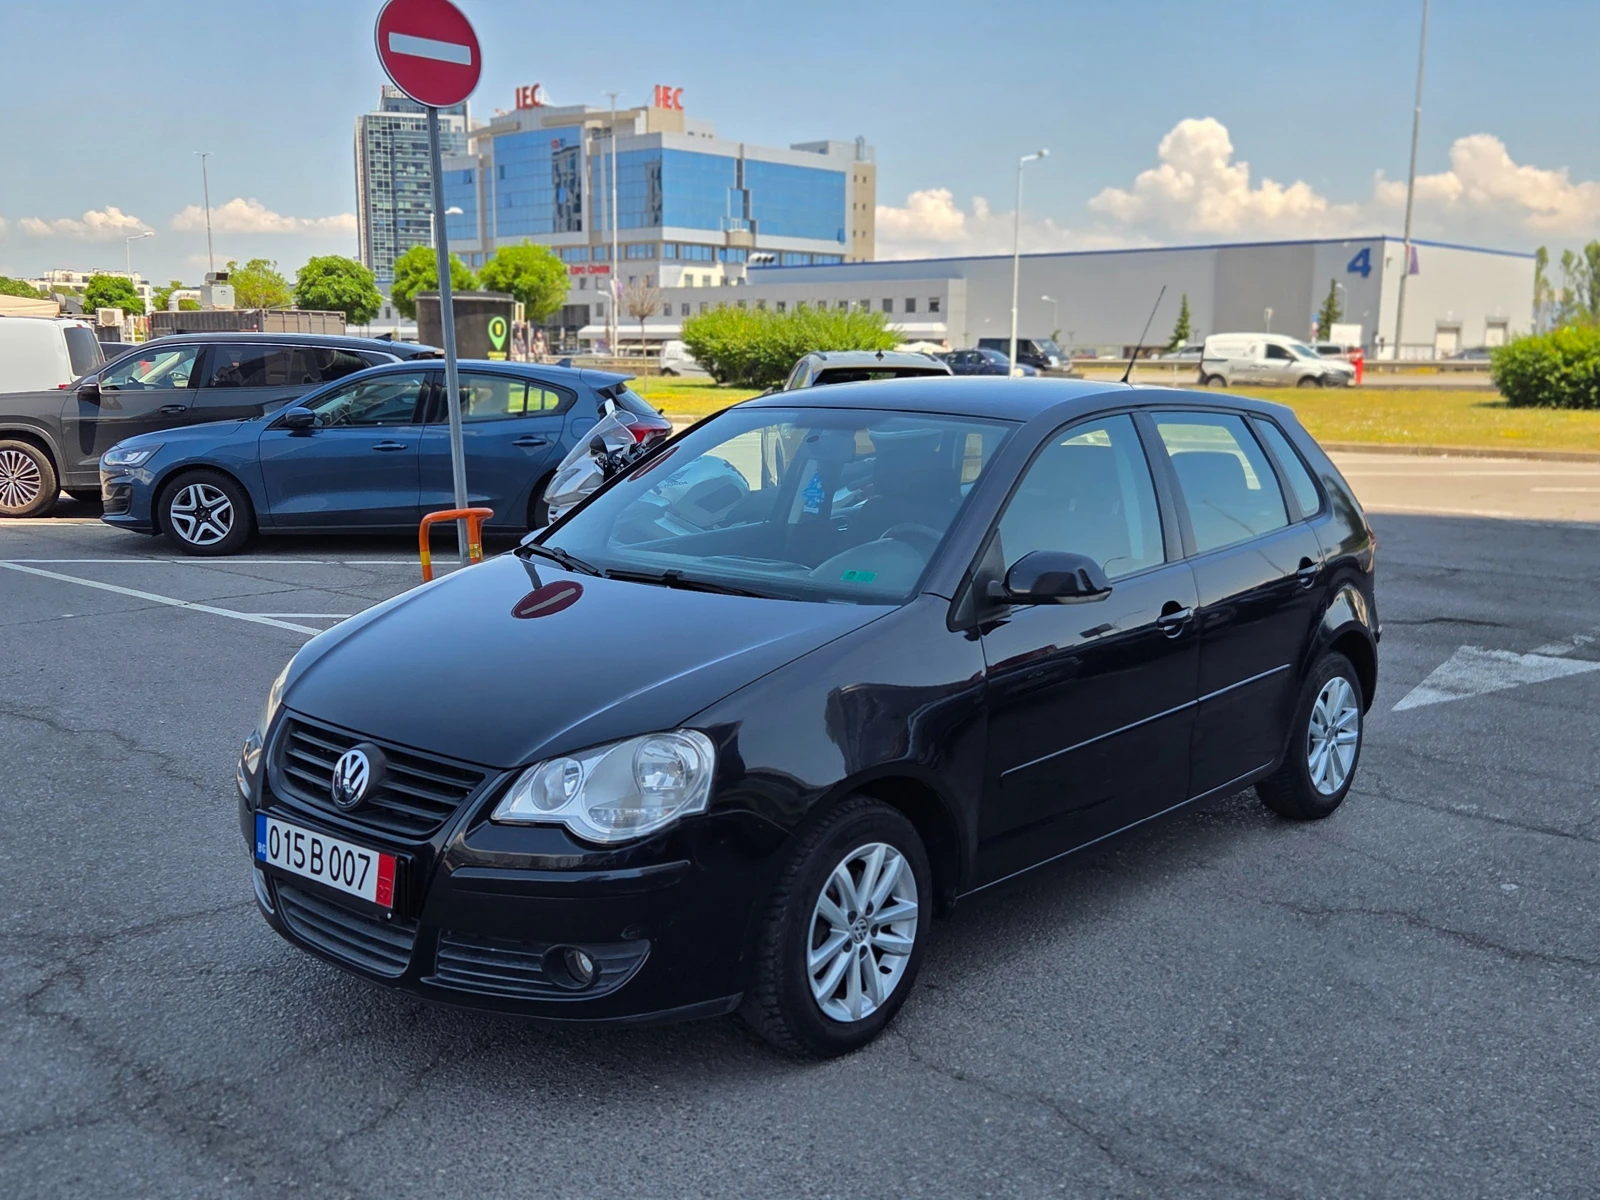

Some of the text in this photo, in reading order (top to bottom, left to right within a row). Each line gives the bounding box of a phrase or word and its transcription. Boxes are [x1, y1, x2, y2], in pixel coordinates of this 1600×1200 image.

[516, 83, 542, 109] IEC
[654, 84, 684, 110] IEC
[1347, 248, 1372, 278] 4
[257, 825, 371, 890] BG 015B007
